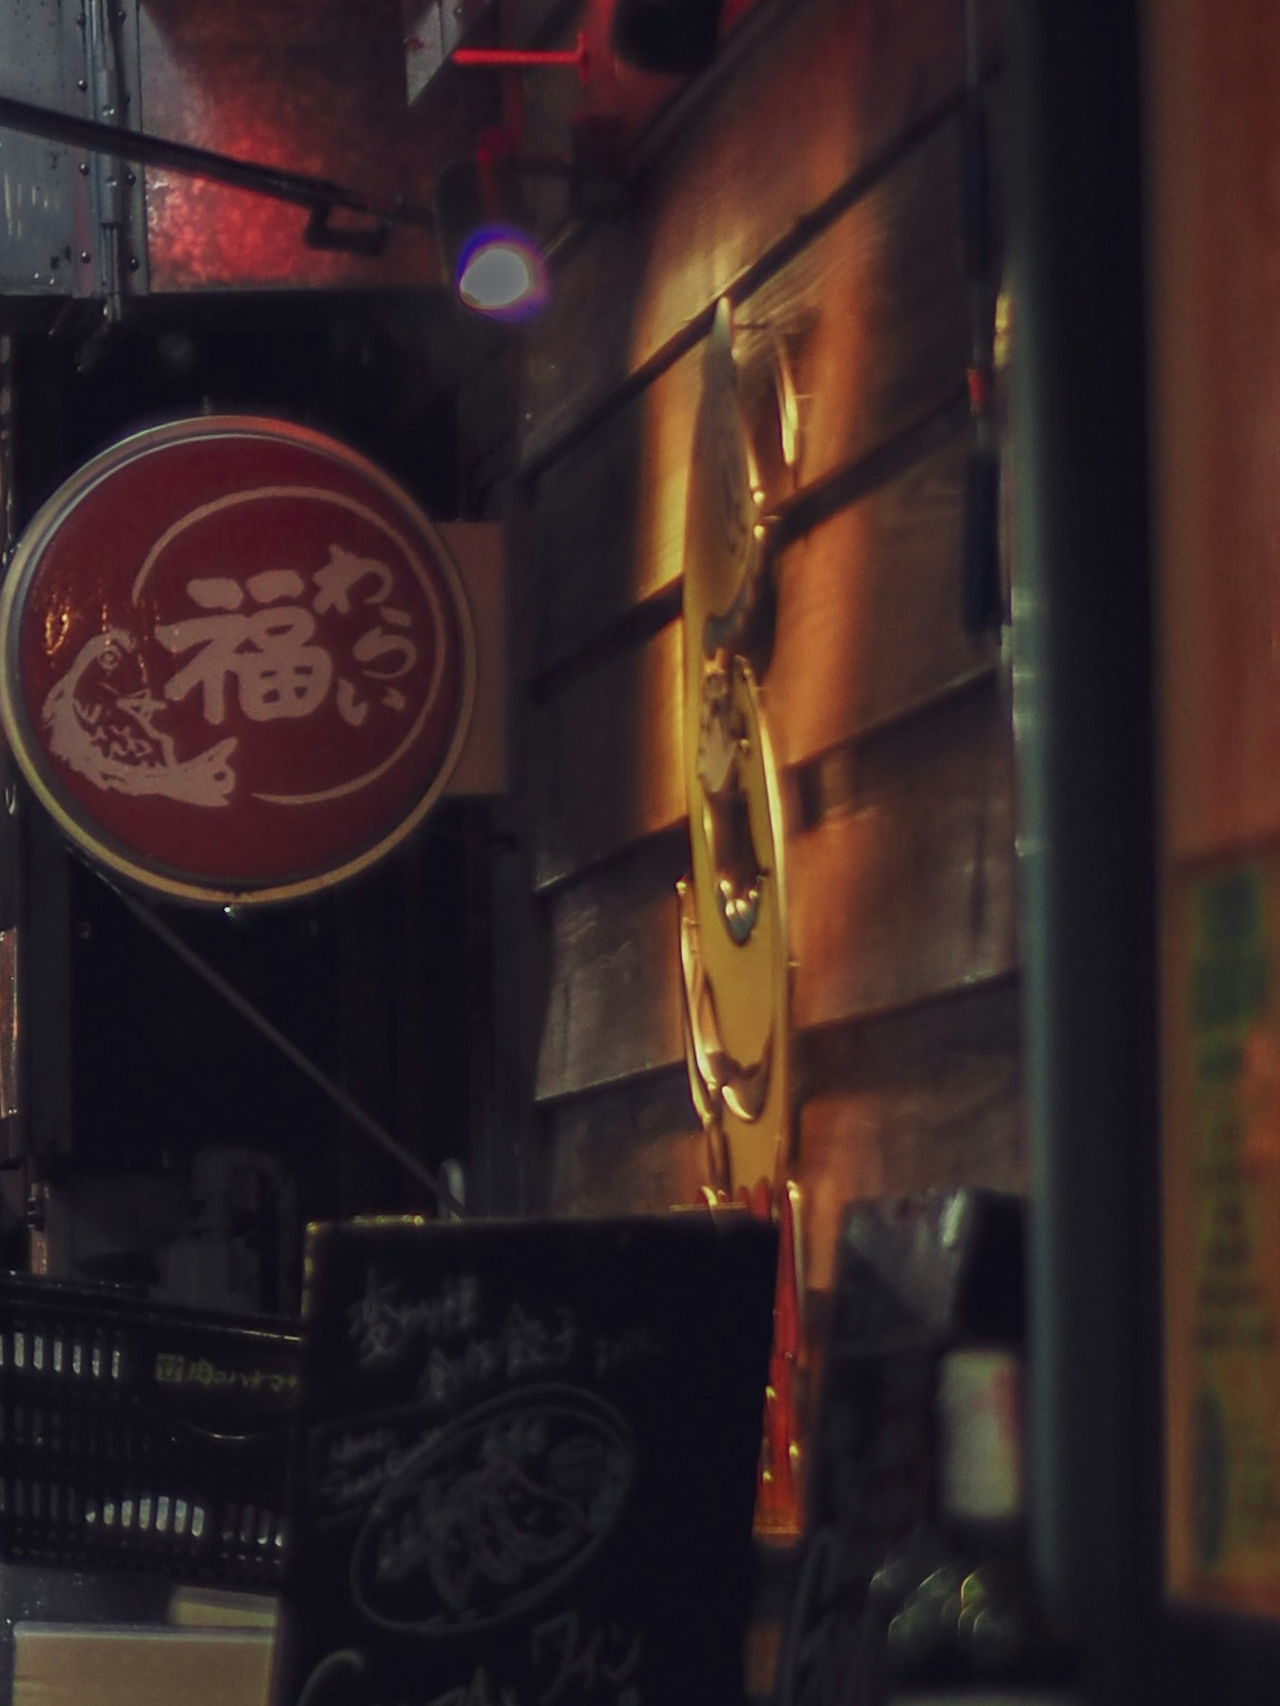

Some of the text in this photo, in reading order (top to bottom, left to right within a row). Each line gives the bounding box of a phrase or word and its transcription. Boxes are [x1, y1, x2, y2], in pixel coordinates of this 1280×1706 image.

[155, 568, 332, 725] 福
[311, 543, 418, 728] わらい
